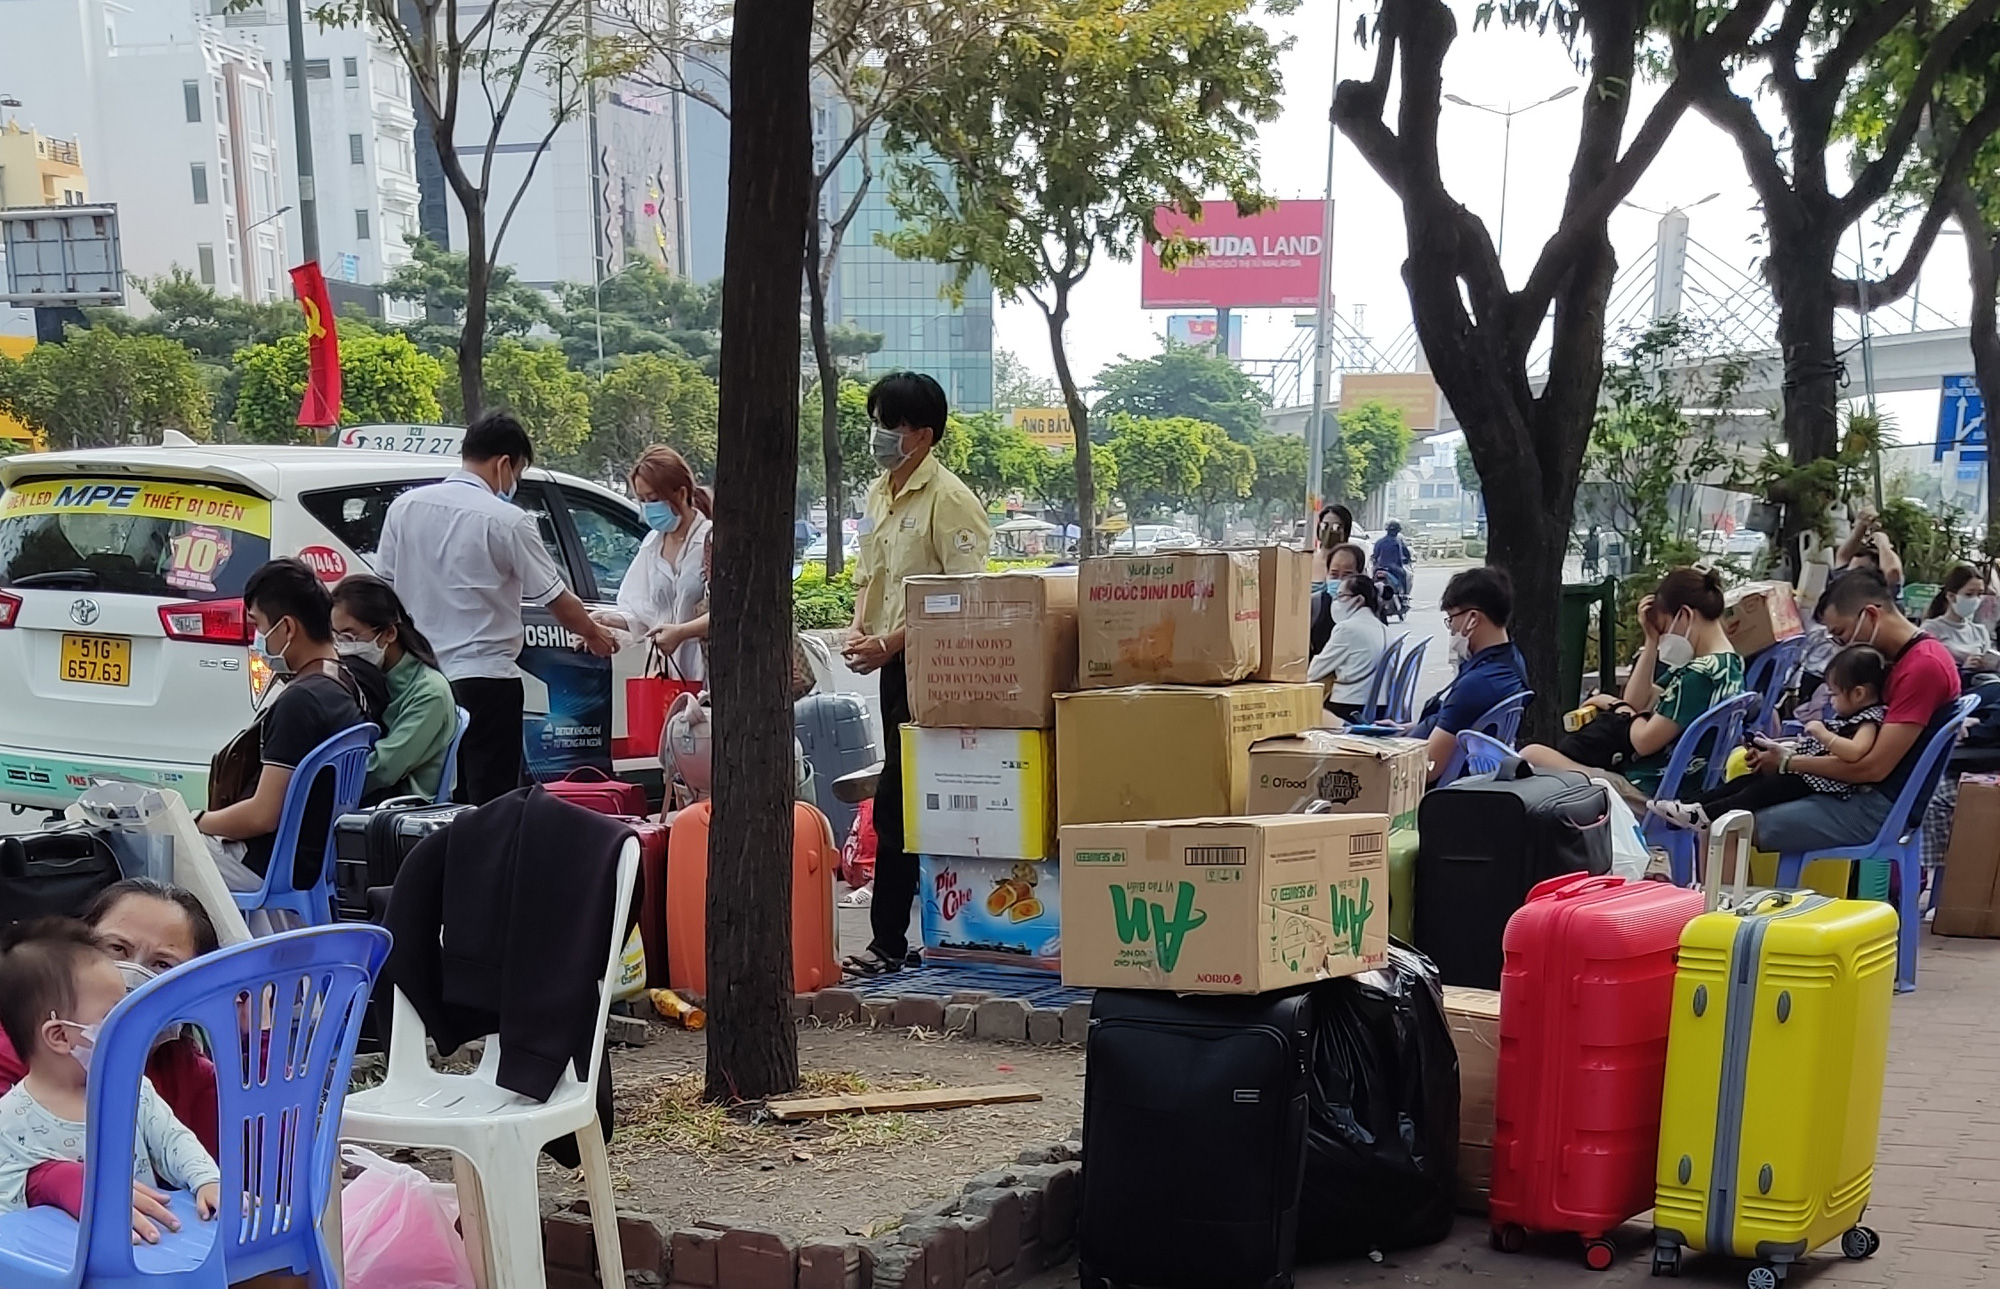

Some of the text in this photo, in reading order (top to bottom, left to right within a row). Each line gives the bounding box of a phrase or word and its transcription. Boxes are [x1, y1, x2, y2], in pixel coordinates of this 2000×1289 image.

[1263, 236, 1323, 255] LAND
[30, 491, 52, 506] LED
[53, 486, 142, 508] MPE
[143, 490, 184, 511] THIẾT
[186, 498, 204, 517] BỊ
[173, 536, 229, 573] 10%
[1089, 582, 1112, 601] NGŨ
[1114, 579, 1138, 600] CỐC
[1140, 584, 1168, 600] DINH
[521, 624, 578, 648] OSHIB
[81, 639, 111, 659] 51G
[68, 660, 122, 682] 657.63
[1109, 881, 1207, 973] An
[1329, 877, 1374, 959] An
[1197, 973, 1231, 984] ORION
